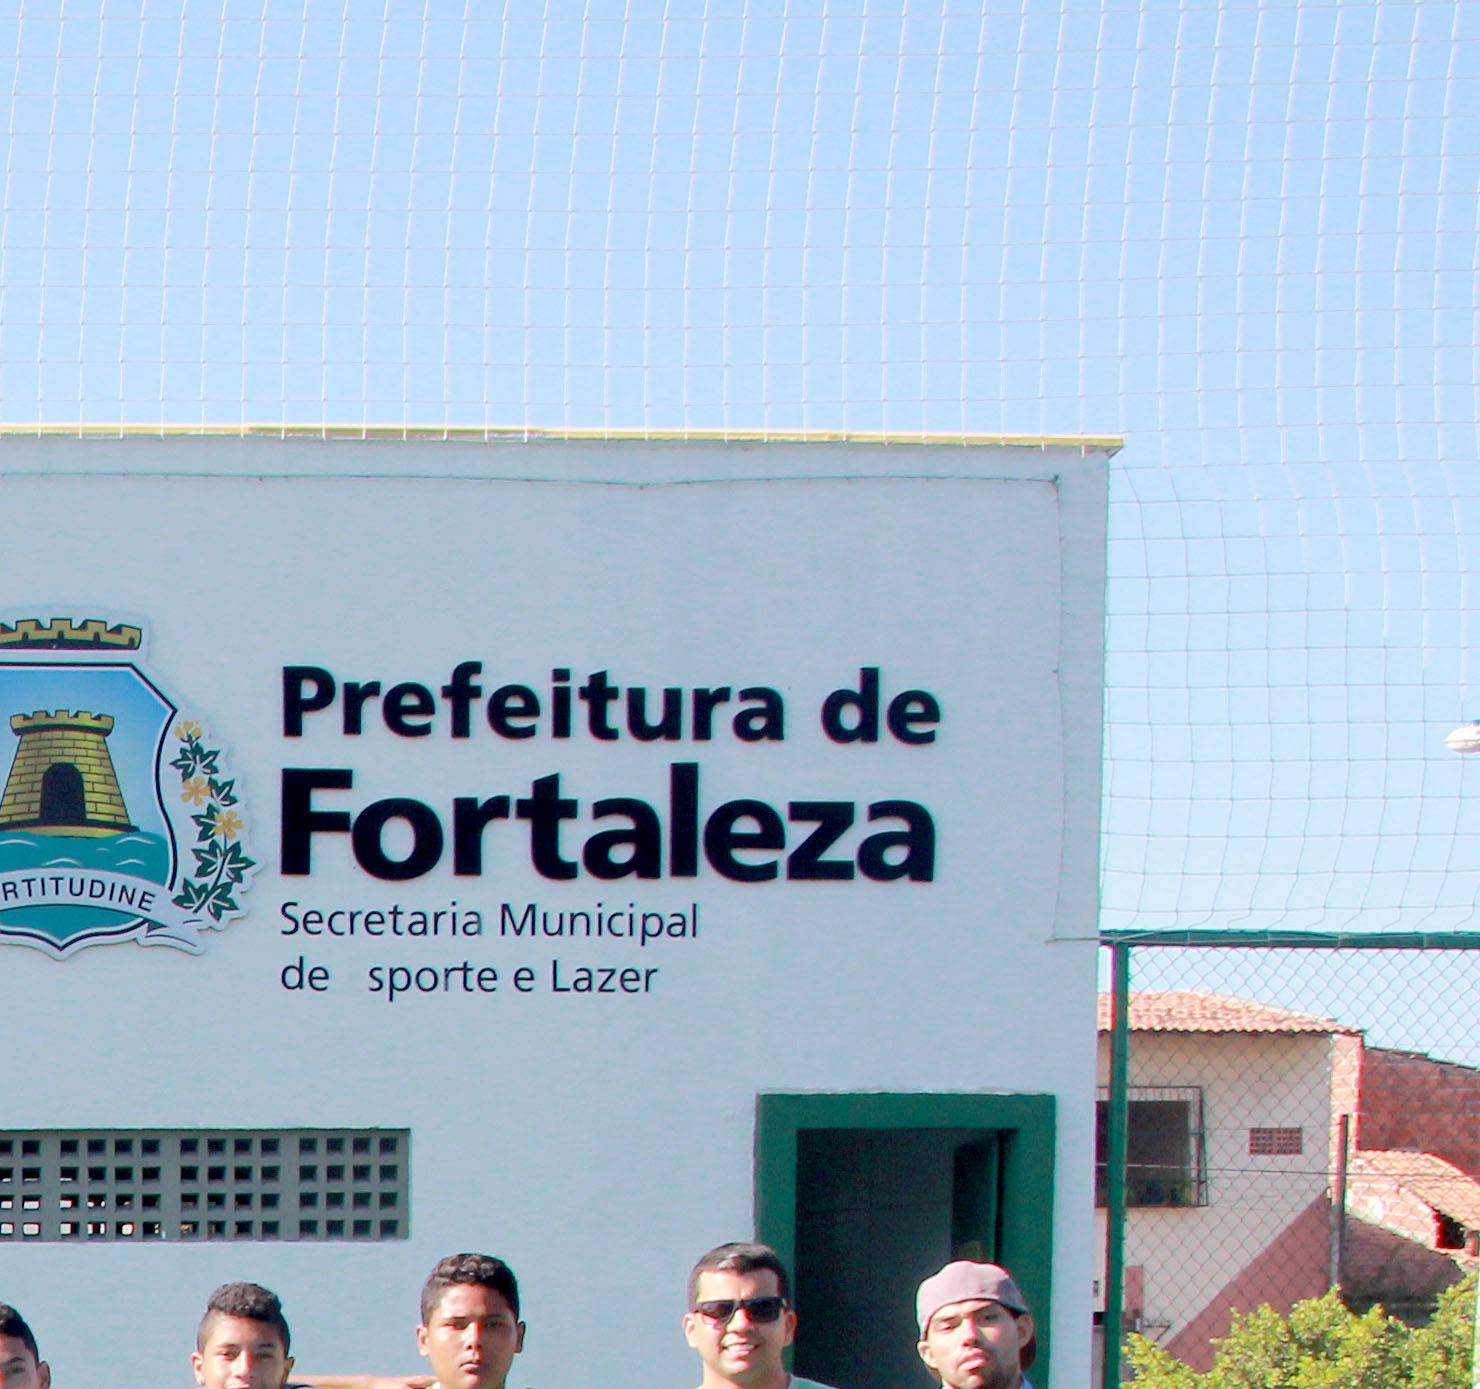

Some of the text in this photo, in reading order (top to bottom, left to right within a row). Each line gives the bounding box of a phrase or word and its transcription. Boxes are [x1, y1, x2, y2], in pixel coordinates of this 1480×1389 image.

[283, 661, 940, 745] Prefeitura de
[281, 762, 935, 883] Fortaleza
[281, 902, 696, 946] Secretaria Municipal
[281, 957, 658, 1002] de sporte e Lazer
